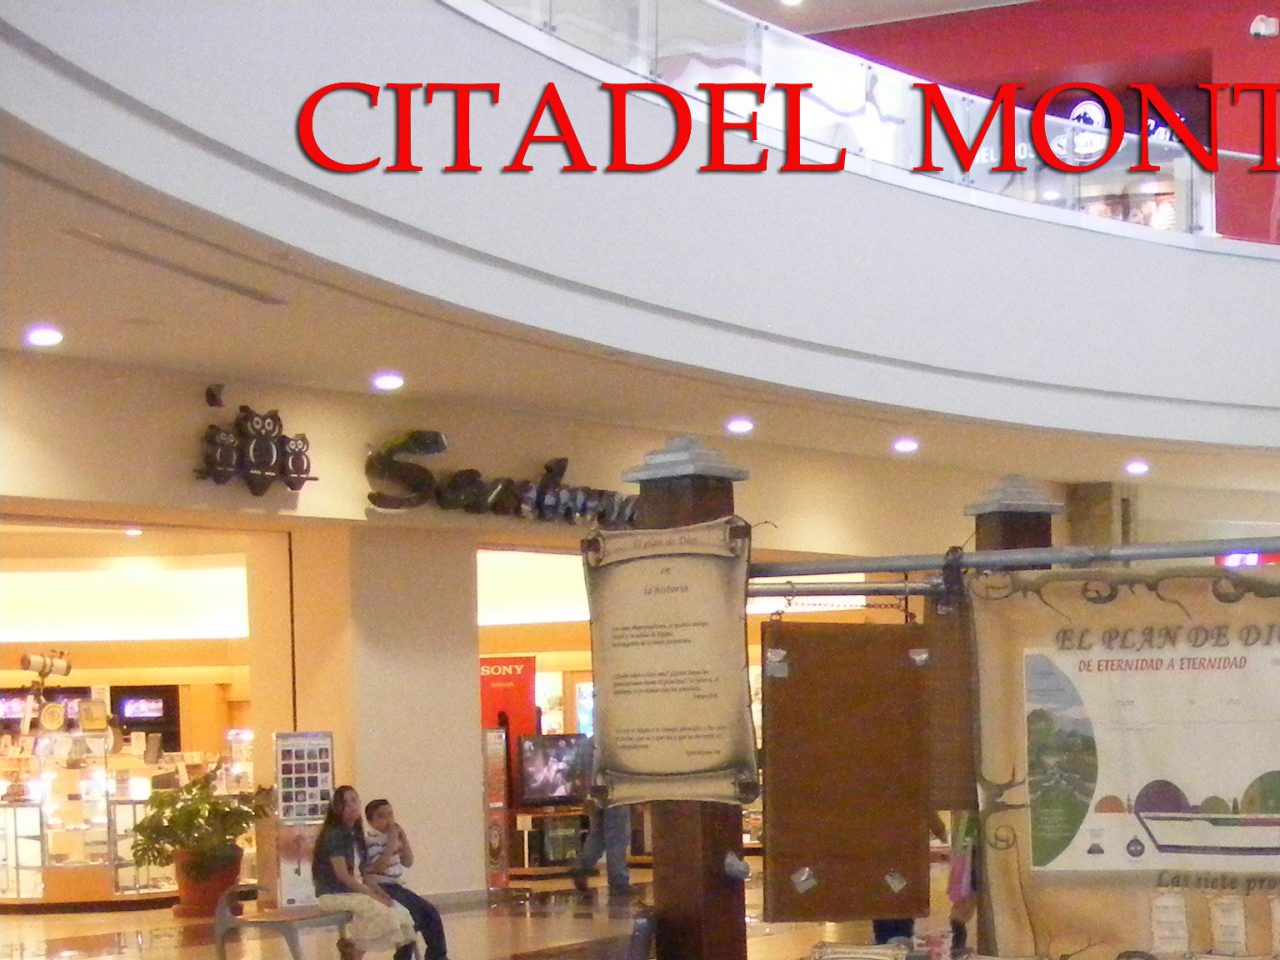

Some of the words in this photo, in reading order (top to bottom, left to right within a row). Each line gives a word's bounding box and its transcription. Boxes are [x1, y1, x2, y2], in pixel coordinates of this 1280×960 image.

[1055, 627, 1094, 651] EL
[1100, 625, 1182, 651] PLAN
[1187, 625, 1231, 649] DE
[480, 664, 525, 676] SONY
[1077, 659, 1094, 673] DE
[1096, 658, 1165, 673] ETERNIDAD
[1166, 657, 1177, 671] A
[1179, 656, 1248, 672] ETERNIDAD
